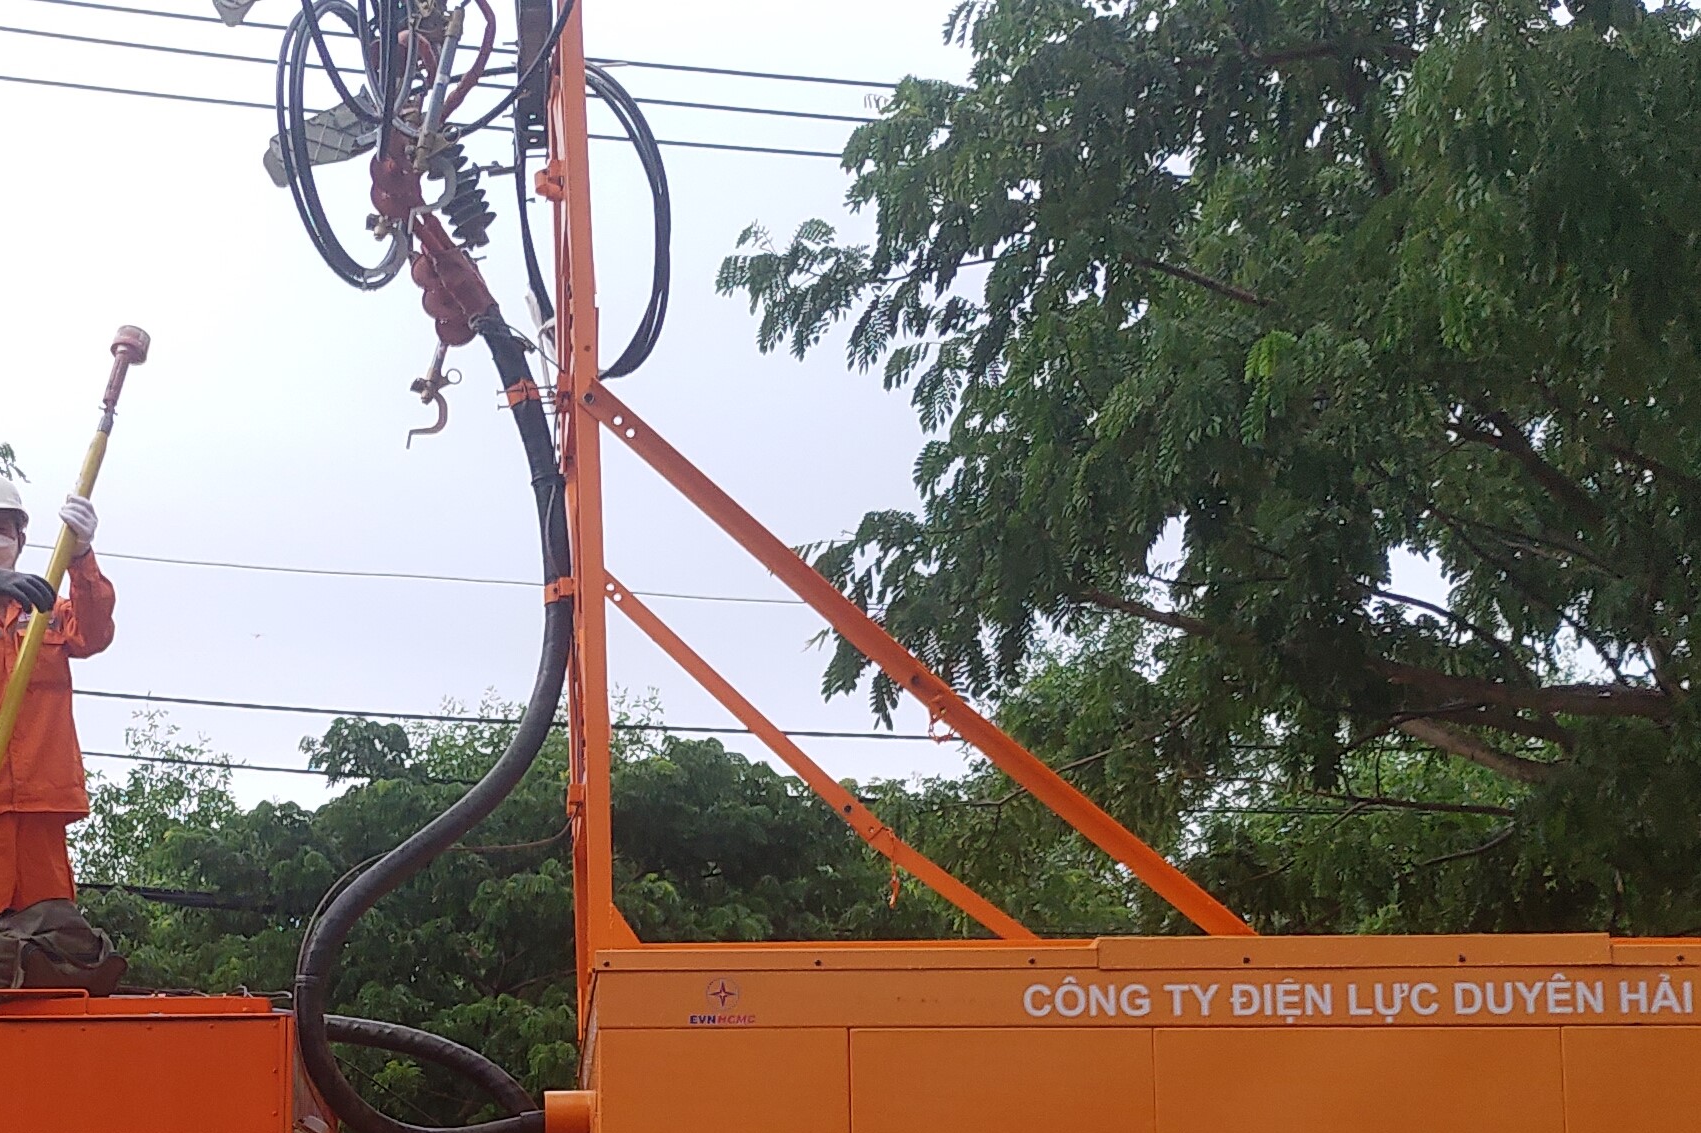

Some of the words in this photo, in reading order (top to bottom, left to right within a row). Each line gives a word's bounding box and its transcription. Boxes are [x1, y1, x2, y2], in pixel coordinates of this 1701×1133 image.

[1023, 976, 1151, 1017] CÔNG
[1163, 984, 1220, 1016] TY
[1229, 978, 1333, 1024] ĐIỆN
[1348, 982, 1439, 1023] LỰC
[1454, 972, 1605, 1015] DUYÊN
[1619, 973, 1694, 1014] HẢI
